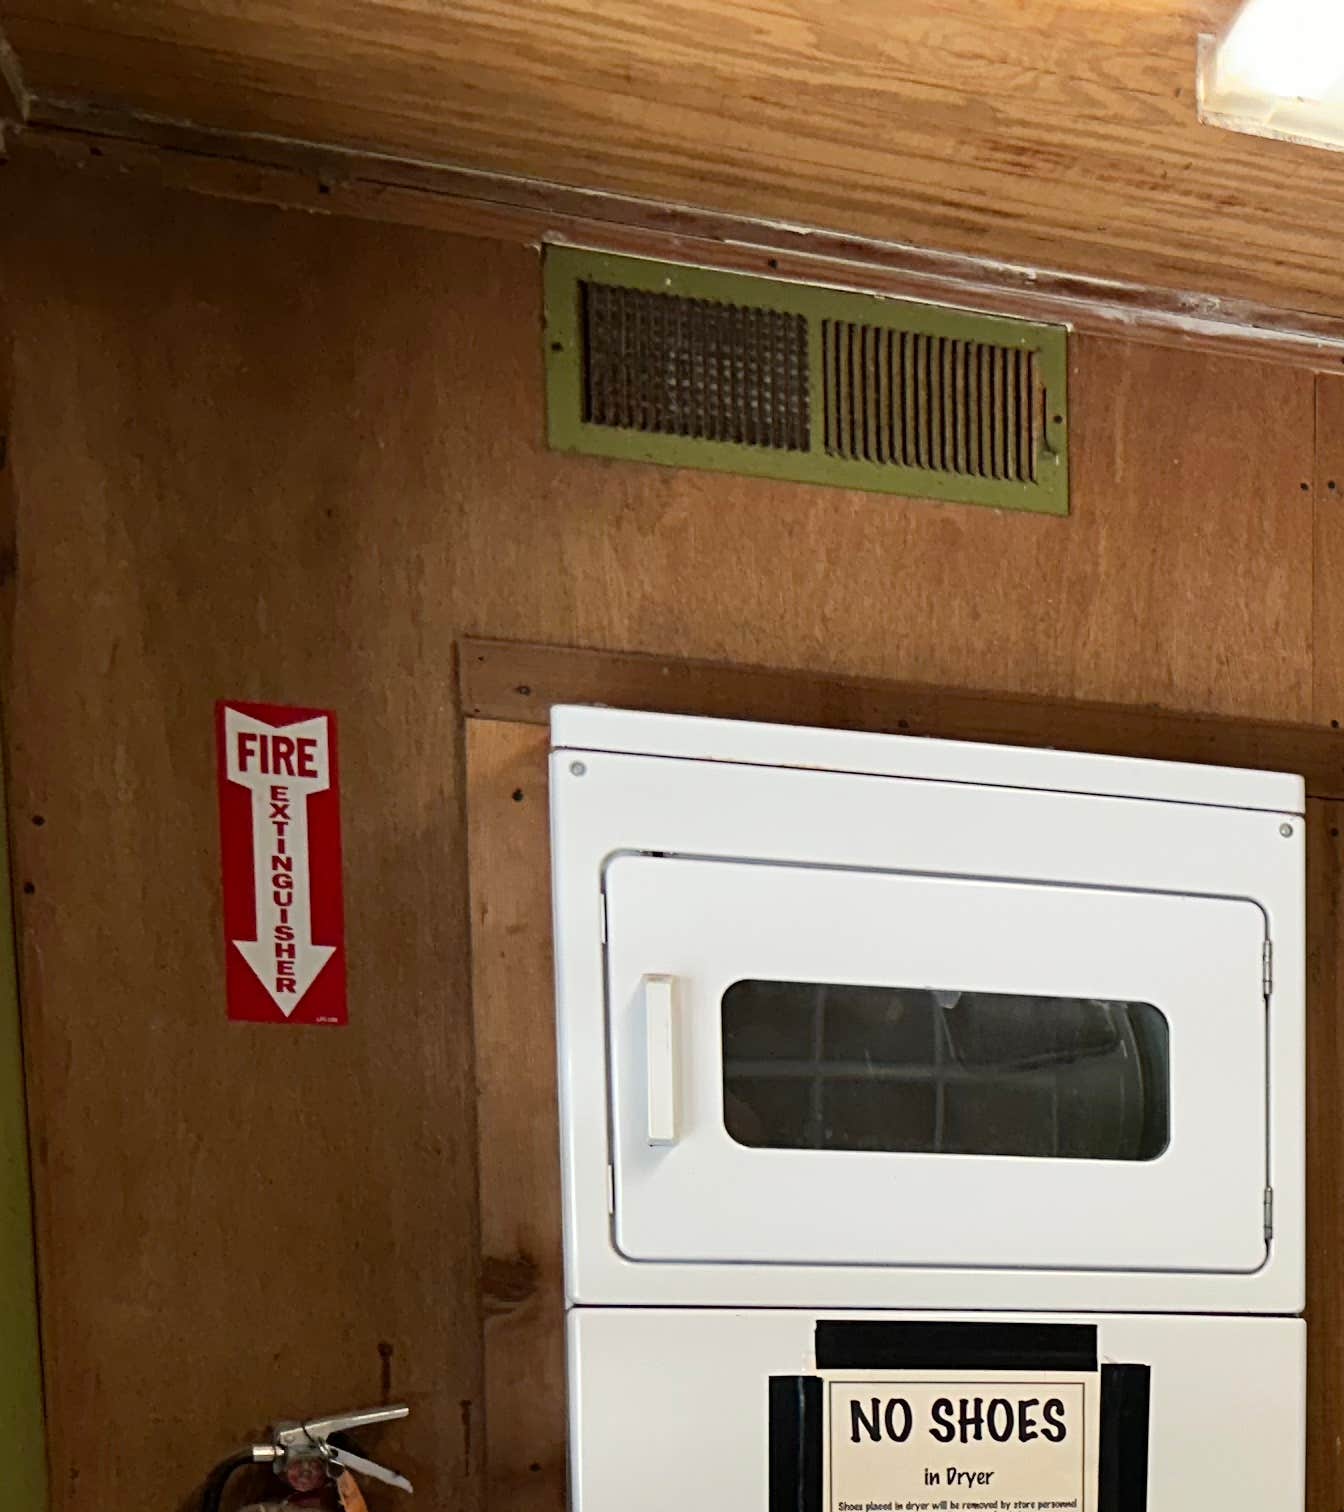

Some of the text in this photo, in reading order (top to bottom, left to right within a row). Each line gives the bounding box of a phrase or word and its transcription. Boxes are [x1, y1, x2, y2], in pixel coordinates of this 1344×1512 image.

[237, 732, 318, 778] FIRE
[269, 785, 296, 994] EXTINGUISHER
[850, 1397, 1067, 1444] NO SHOES
[924, 1467, 995, 1488] in Dryer
[839, 1498, 1077, 1512] Shoes placed in dryer will be removed by store personnel
